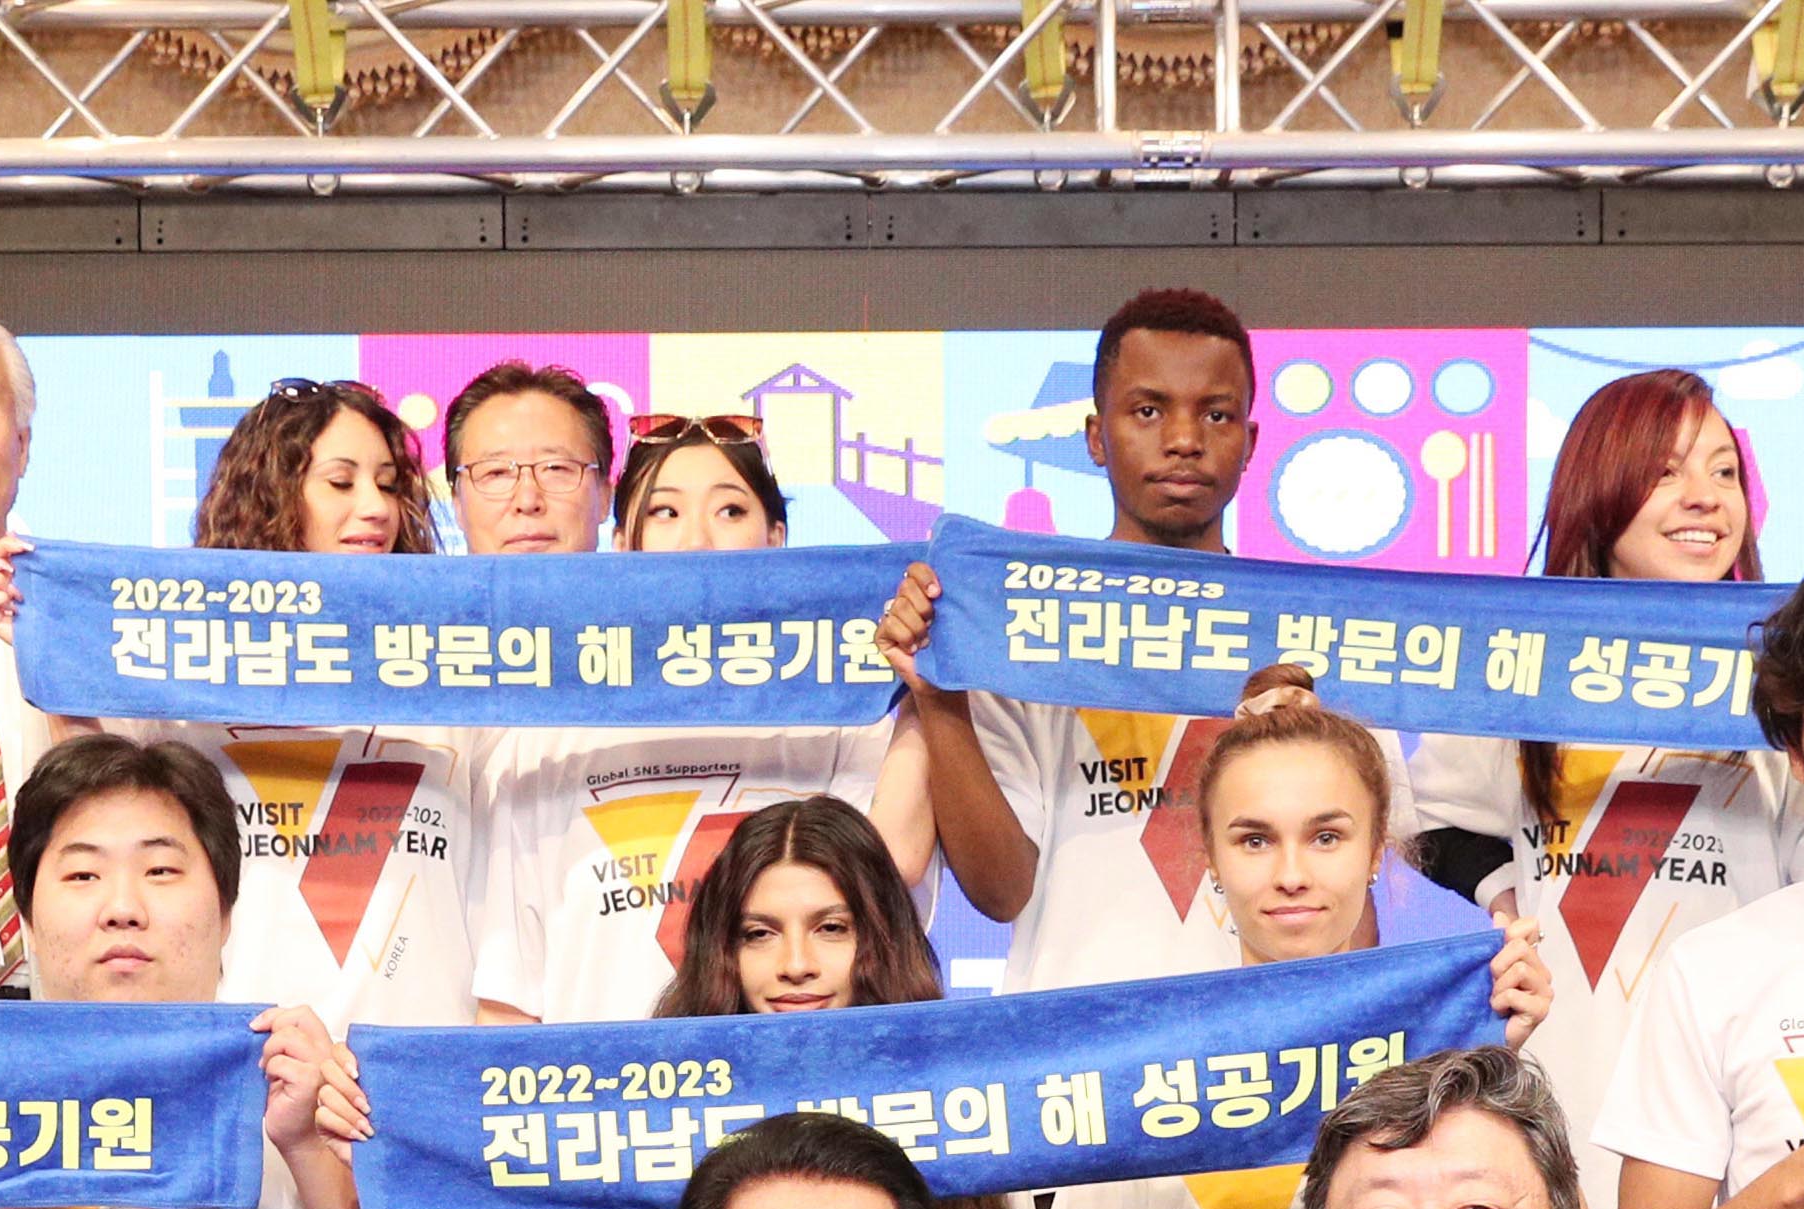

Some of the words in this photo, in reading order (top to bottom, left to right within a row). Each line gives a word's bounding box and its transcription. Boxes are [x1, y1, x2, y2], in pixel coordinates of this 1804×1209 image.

[111, 578, 322, 613] 2022~2023
[1004, 562, 1224, 599] 2022~2023
[110, 617, 352, 687] 전라남도
[375, 624, 551, 688] 방문의
[577, 625, 632, 687] 해
[657, 618, 894, 687] 성공기원
[1006, 598, 1249, 672] 전라남도
[1276, 614, 1461, 690] 방문의
[1486, 628, 1545, 697] 해
[587, 770, 629, 786] Global
[634, 765, 661, 776] SNS
[666, 763, 741, 775] Supporters
[1080, 757, 1148, 785] VISIT
[239, 802, 303, 826] VISIT
[244, 830, 377, 857] JEONNAM
[391, 830, 447, 860] YEAR
[592, 853, 657, 884] VISIT
[1651, 856, 1727, 887] YEAR
[384, 935, 409, 980] KOREA
[481, 1059, 732, 1106] 2022~2023
[1036, 1070, 1106, 1146] 해
